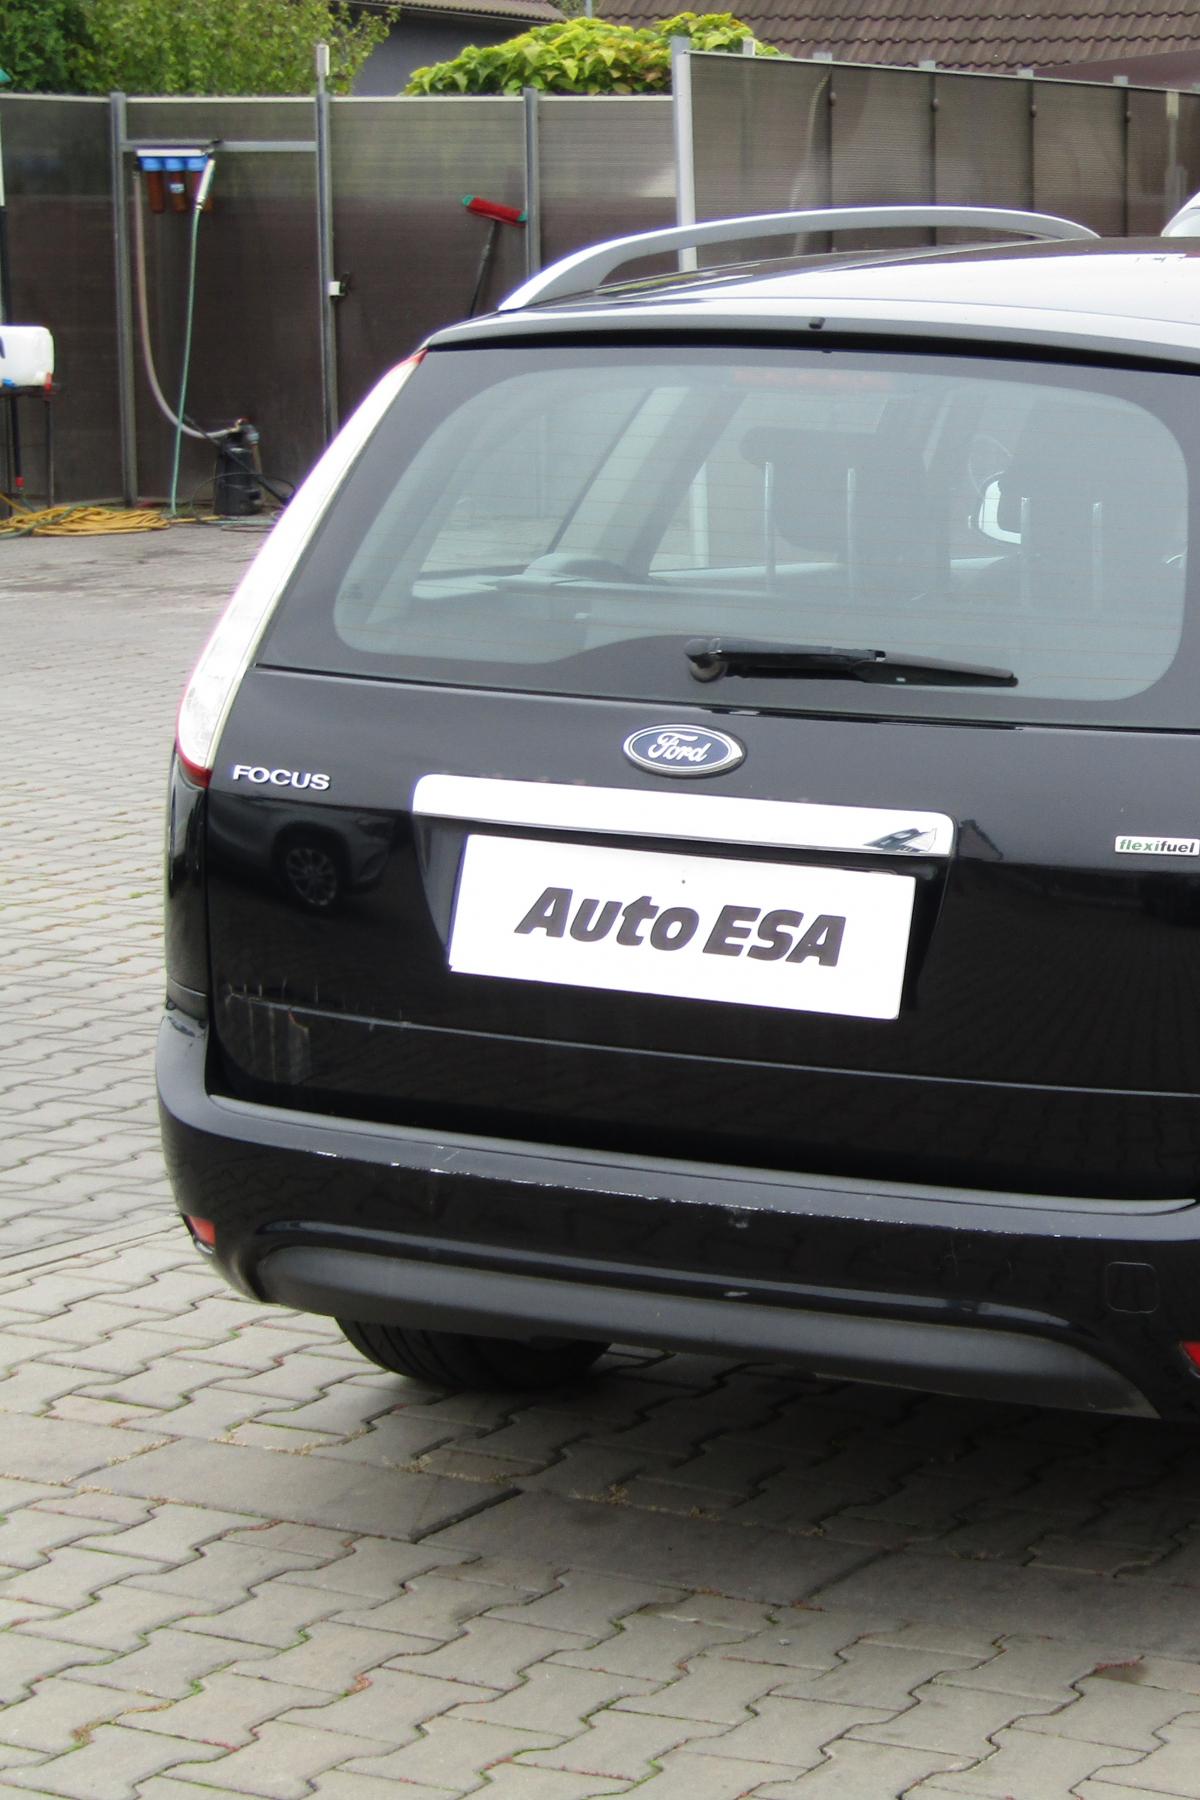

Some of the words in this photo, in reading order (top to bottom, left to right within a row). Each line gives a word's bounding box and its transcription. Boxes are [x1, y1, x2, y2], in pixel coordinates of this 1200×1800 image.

[648, 732, 712, 762] Ford
[232, 764, 331, 790] FOCUS
[1119, 839, 1195, 853] flexifuel
[513, 886, 700, 951] Auto
[702, 904, 847, 967] ESA
